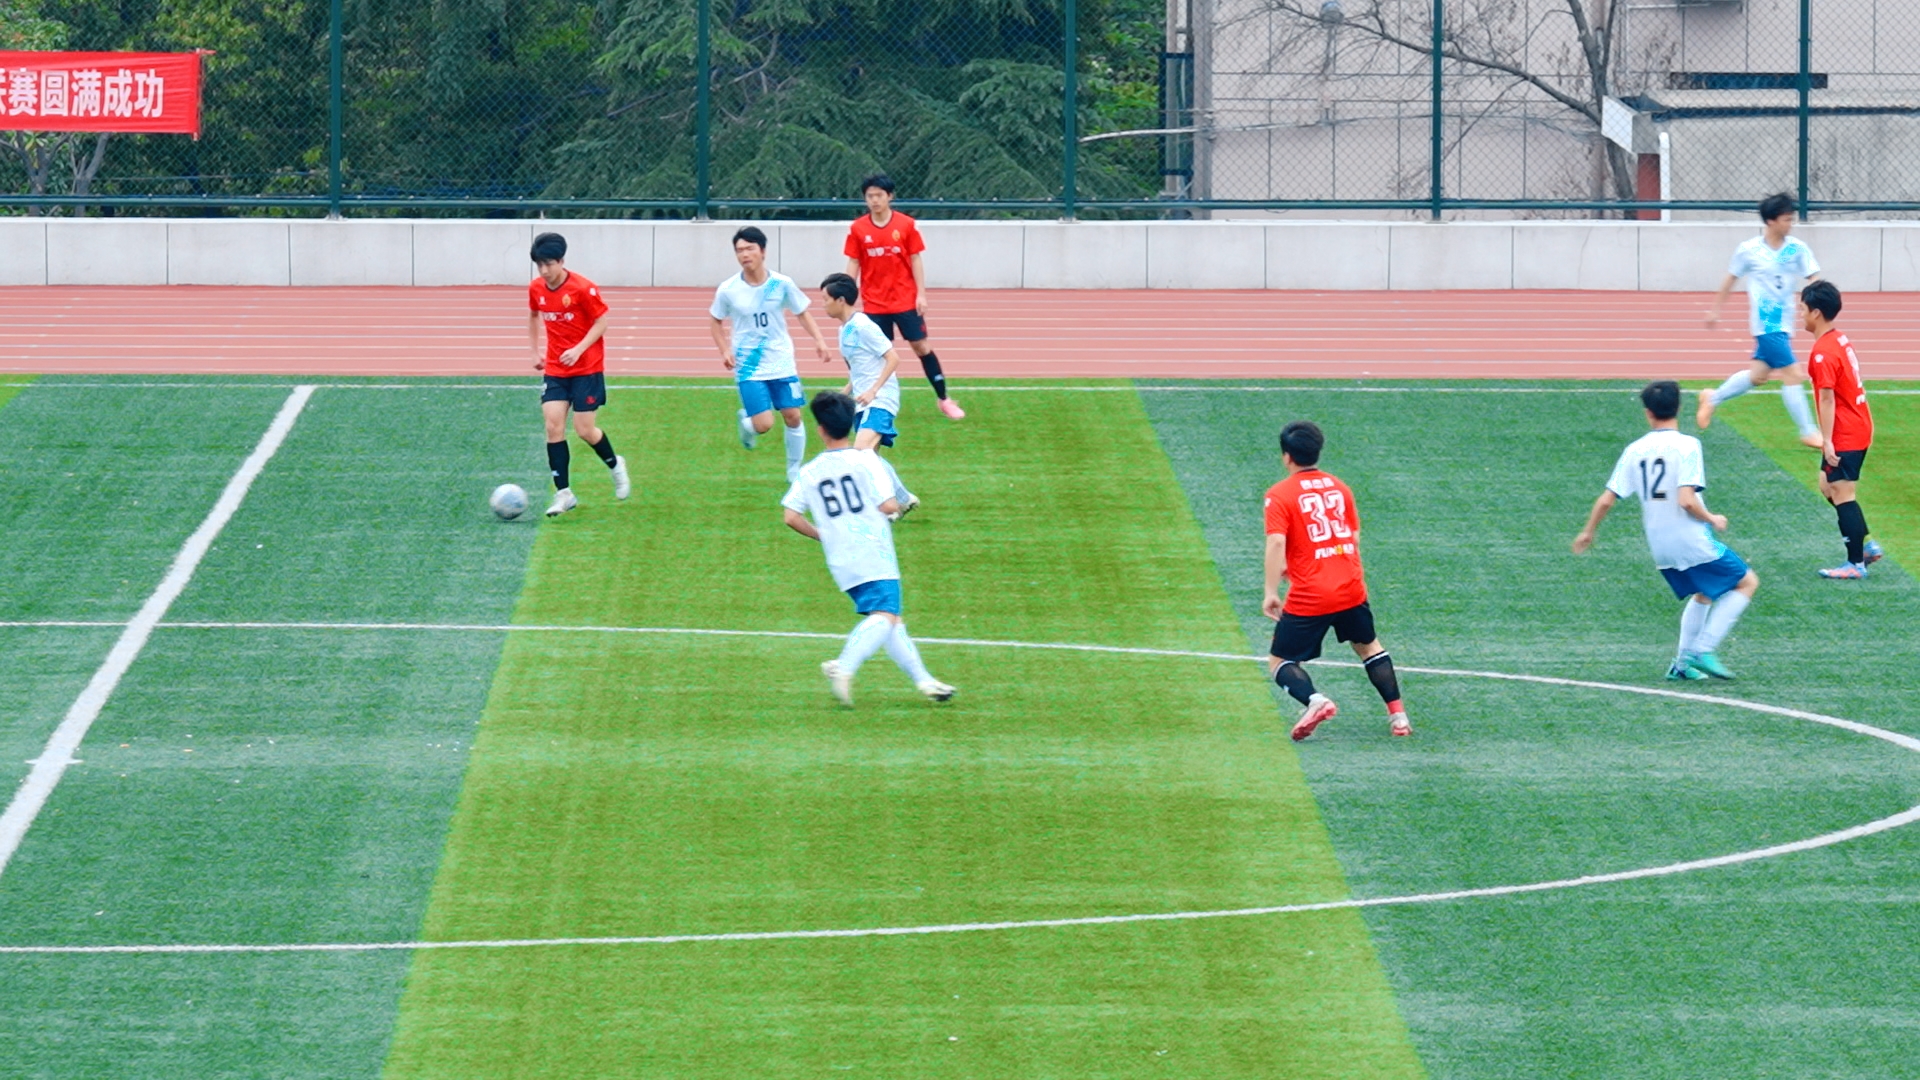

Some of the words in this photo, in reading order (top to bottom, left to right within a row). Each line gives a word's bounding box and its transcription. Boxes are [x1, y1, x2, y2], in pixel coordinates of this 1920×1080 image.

[753, 312, 769, 328] 10
[819, 475, 864, 517] 60
[1639, 458, 1667, 500] 12
[1298, 490, 1352, 542] 33
